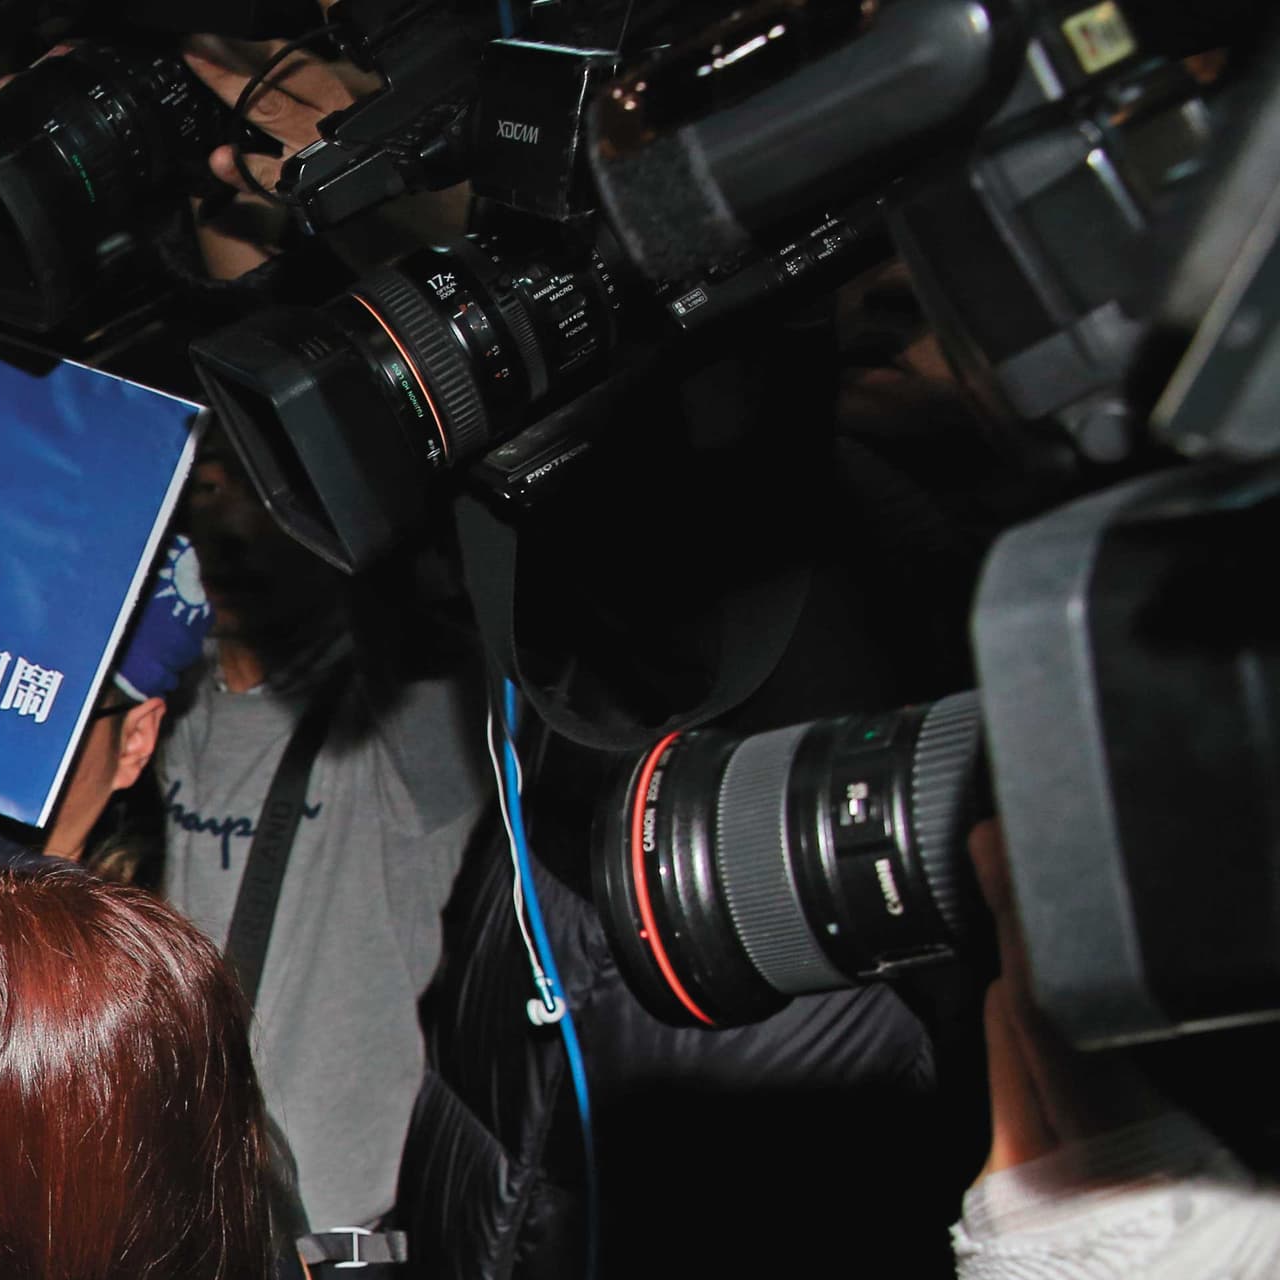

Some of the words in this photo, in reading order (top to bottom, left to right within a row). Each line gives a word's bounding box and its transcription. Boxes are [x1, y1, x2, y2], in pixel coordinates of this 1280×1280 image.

[497, 119, 540, 144] XDCAM
[548, 284, 575, 303] MACRO
[407, 390, 425, 419] FUJINON
